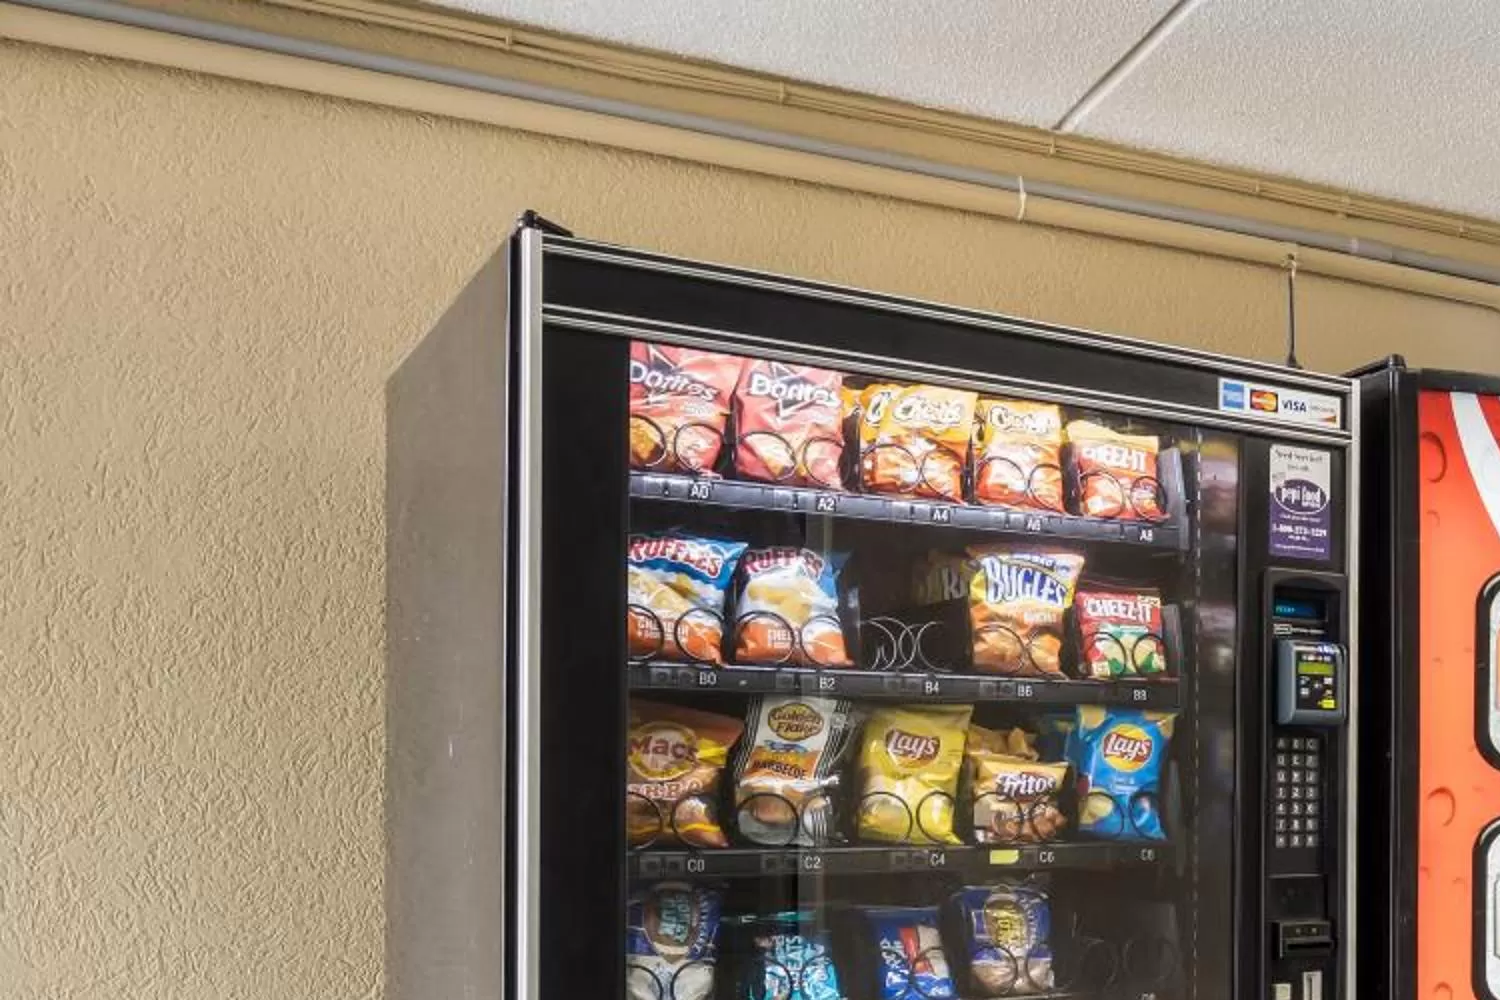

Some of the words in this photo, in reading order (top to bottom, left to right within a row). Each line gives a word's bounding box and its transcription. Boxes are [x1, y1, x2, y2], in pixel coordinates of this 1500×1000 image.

[1281, 400, 1307, 412] VISA
[690, 483, 709, 499] A0
[818, 498, 835, 511] A2
[933, 508, 949, 522] A4
[629, 537, 723, 578] RUFFLES
[983, 556, 1067, 607] BUGLES
[700, 671, 717, 685] B0
[819, 677, 835, 690] B2
[925, 682, 940, 694] B4
[1017, 684, 1032, 697] B6
[996, 772, 1057, 798] Fritos
[804, 855, 821, 870] C2
[930, 853, 946, 867] C4
[1039, 851, 1054, 864] C6
[687, 859, 705, 873] C0
